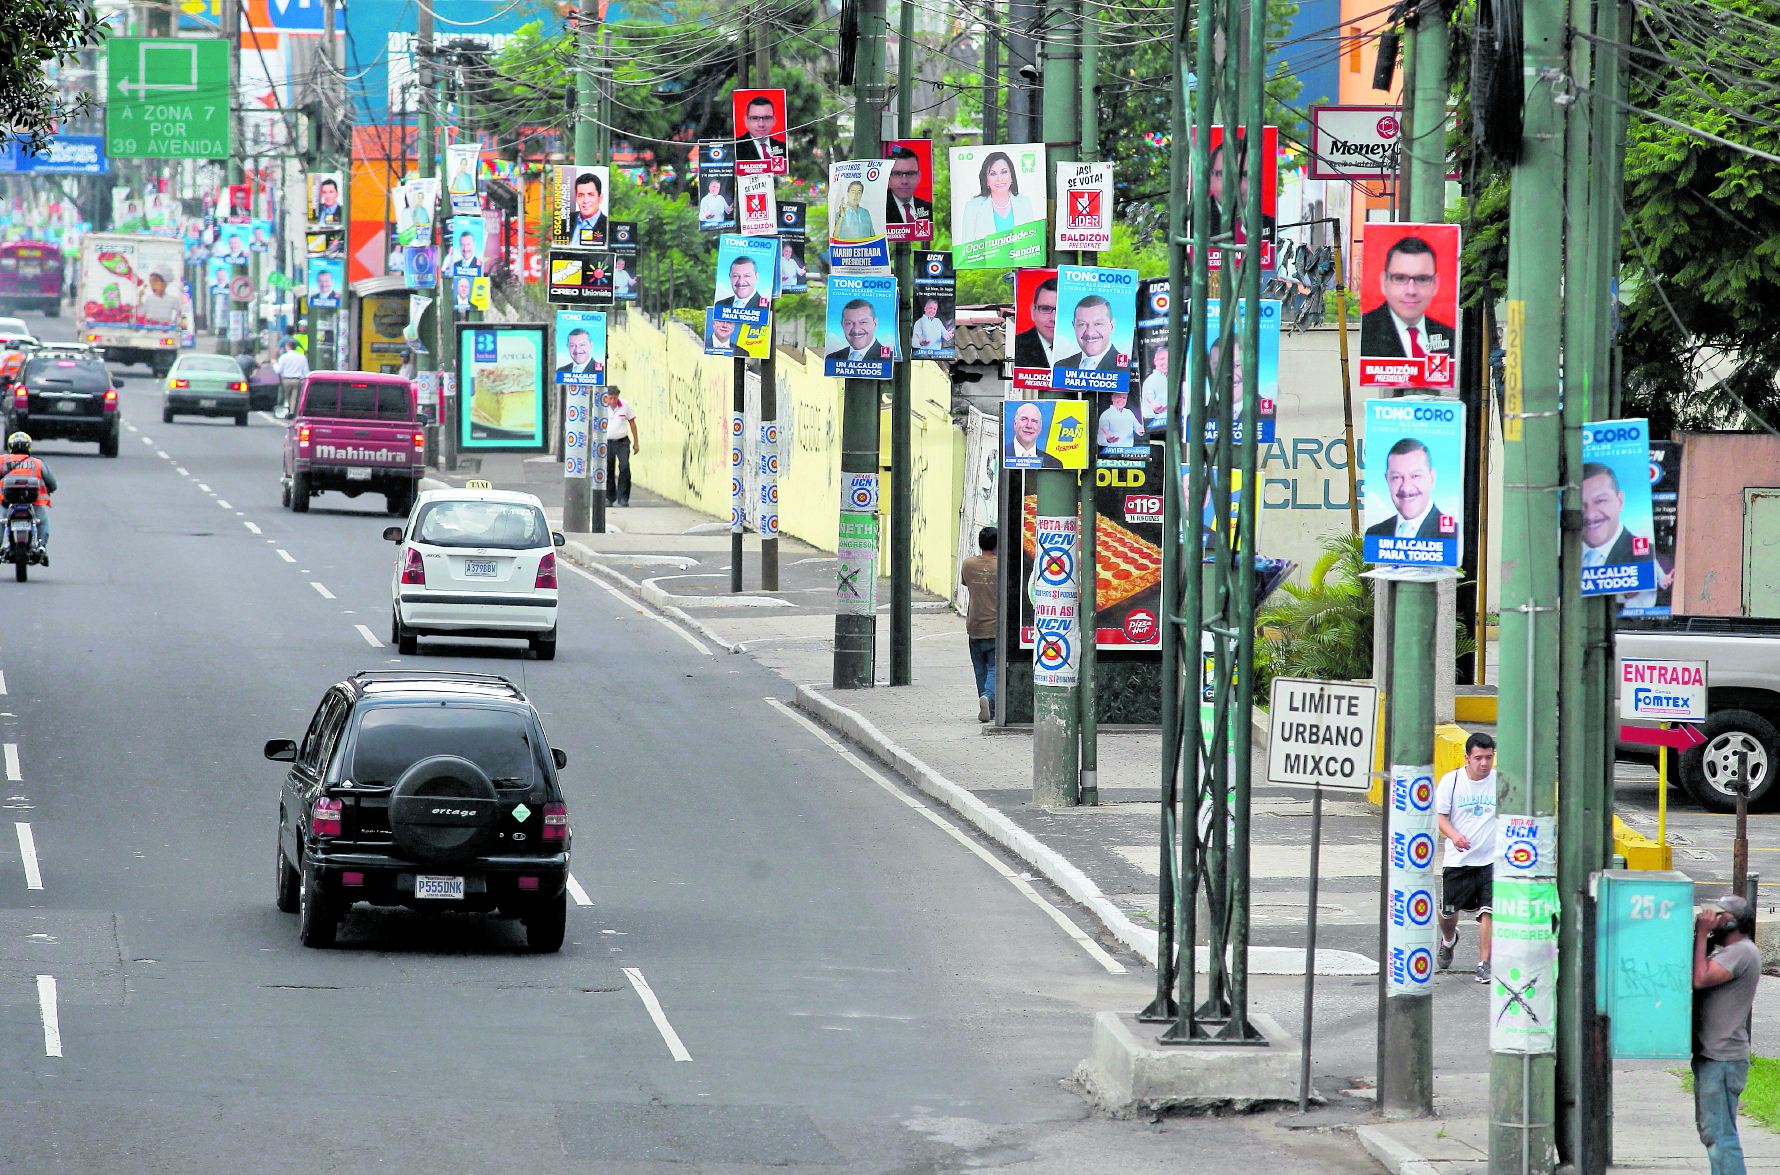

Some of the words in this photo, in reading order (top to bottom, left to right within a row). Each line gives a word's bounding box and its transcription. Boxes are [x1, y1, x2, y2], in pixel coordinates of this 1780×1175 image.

[122, 106, 133, 119] A
[144, 106, 192, 121] ZONA
[204, 106, 215, 120] 7
[150, 124, 186, 137] POR
[112, 140, 136, 154] 39
[149, 140, 222, 154] AVENIDA
[835, 164, 861, 173] NOSOTROS
[1068, 178, 1077, 188] SE
[1079, 173, 1103, 186] VOTA!
[554, 211, 562, 235] OSCAR
[742, 223, 774, 231] BALDIZÓN
[963, 227, 1037, 256] ¡Oportunidades!
[1061, 232, 1109, 242] BALDIZÓN
[833, 248, 852, 257] MARIO
[854, 248, 881, 257] ESTRADA
[1009, 245, 1041, 259] Sandra
[842, 258, 872, 266] PRESIDENTE
[582, 289, 612, 297] Unionista
[732, 309, 760, 317] ALCALDE
[739, 314, 760, 322] TODOS
[749, 328, 766, 336] PAN
[848, 362, 883, 370] ALCALDE
[857, 368, 882, 376] TODOS
[1366, 364, 1418, 375] BALDIZÓN
[1079, 372, 1118, 381] ALCALDE
[1374, 375, 1410, 383] PRESIDENTE
[1065, 379, 1088, 387] PARA
[1089, 380, 1118, 389] TODOS
[1061, 428, 1084, 438] PAN
[316, 445, 406, 462] Mahindra
[1593, 448, 1643, 457] GUATEMALA
[851, 479, 873, 487] UCN
[1078, 469, 1146, 487] OLD
[1040, 520, 1061, 531] VOTA
[1039, 533, 1076, 546] UCN
[1379, 539, 1394, 549] UN
[1395, 540, 1444, 552] ALCALDE
[1379, 550, 1406, 560] PARA
[1407, 551, 1444, 562] TODOS
[1584, 566, 1638, 579] ALCALDE
[1597, 577, 1639, 589] TODOS
[1052, 589, 1060, 599] SÍ
[1036, 605, 1057, 616] VOTA
[1060, 606, 1074, 616] ASI
[1622, 608, 1644, 616] JAVIER
[1037, 618, 1072, 631] UCN
[1132, 627, 1149, 635] Hut
[1624, 664, 1704, 686] ENTRADA
[1289, 692, 1359, 716] LIMITE
[1281, 722, 1363, 748] URBANO
[1284, 753, 1355, 778] MIXCO
[432, 808, 477, 817] ortage
[1506, 826, 1538, 838] UCN
[1395, 831, 1406, 869] UCN
[419, 881, 462, 894] P555DNK
[1394, 889, 1405, 927] UCN
[1630, 894, 1655, 919] 25
[1394, 946, 1405, 985] UCN
